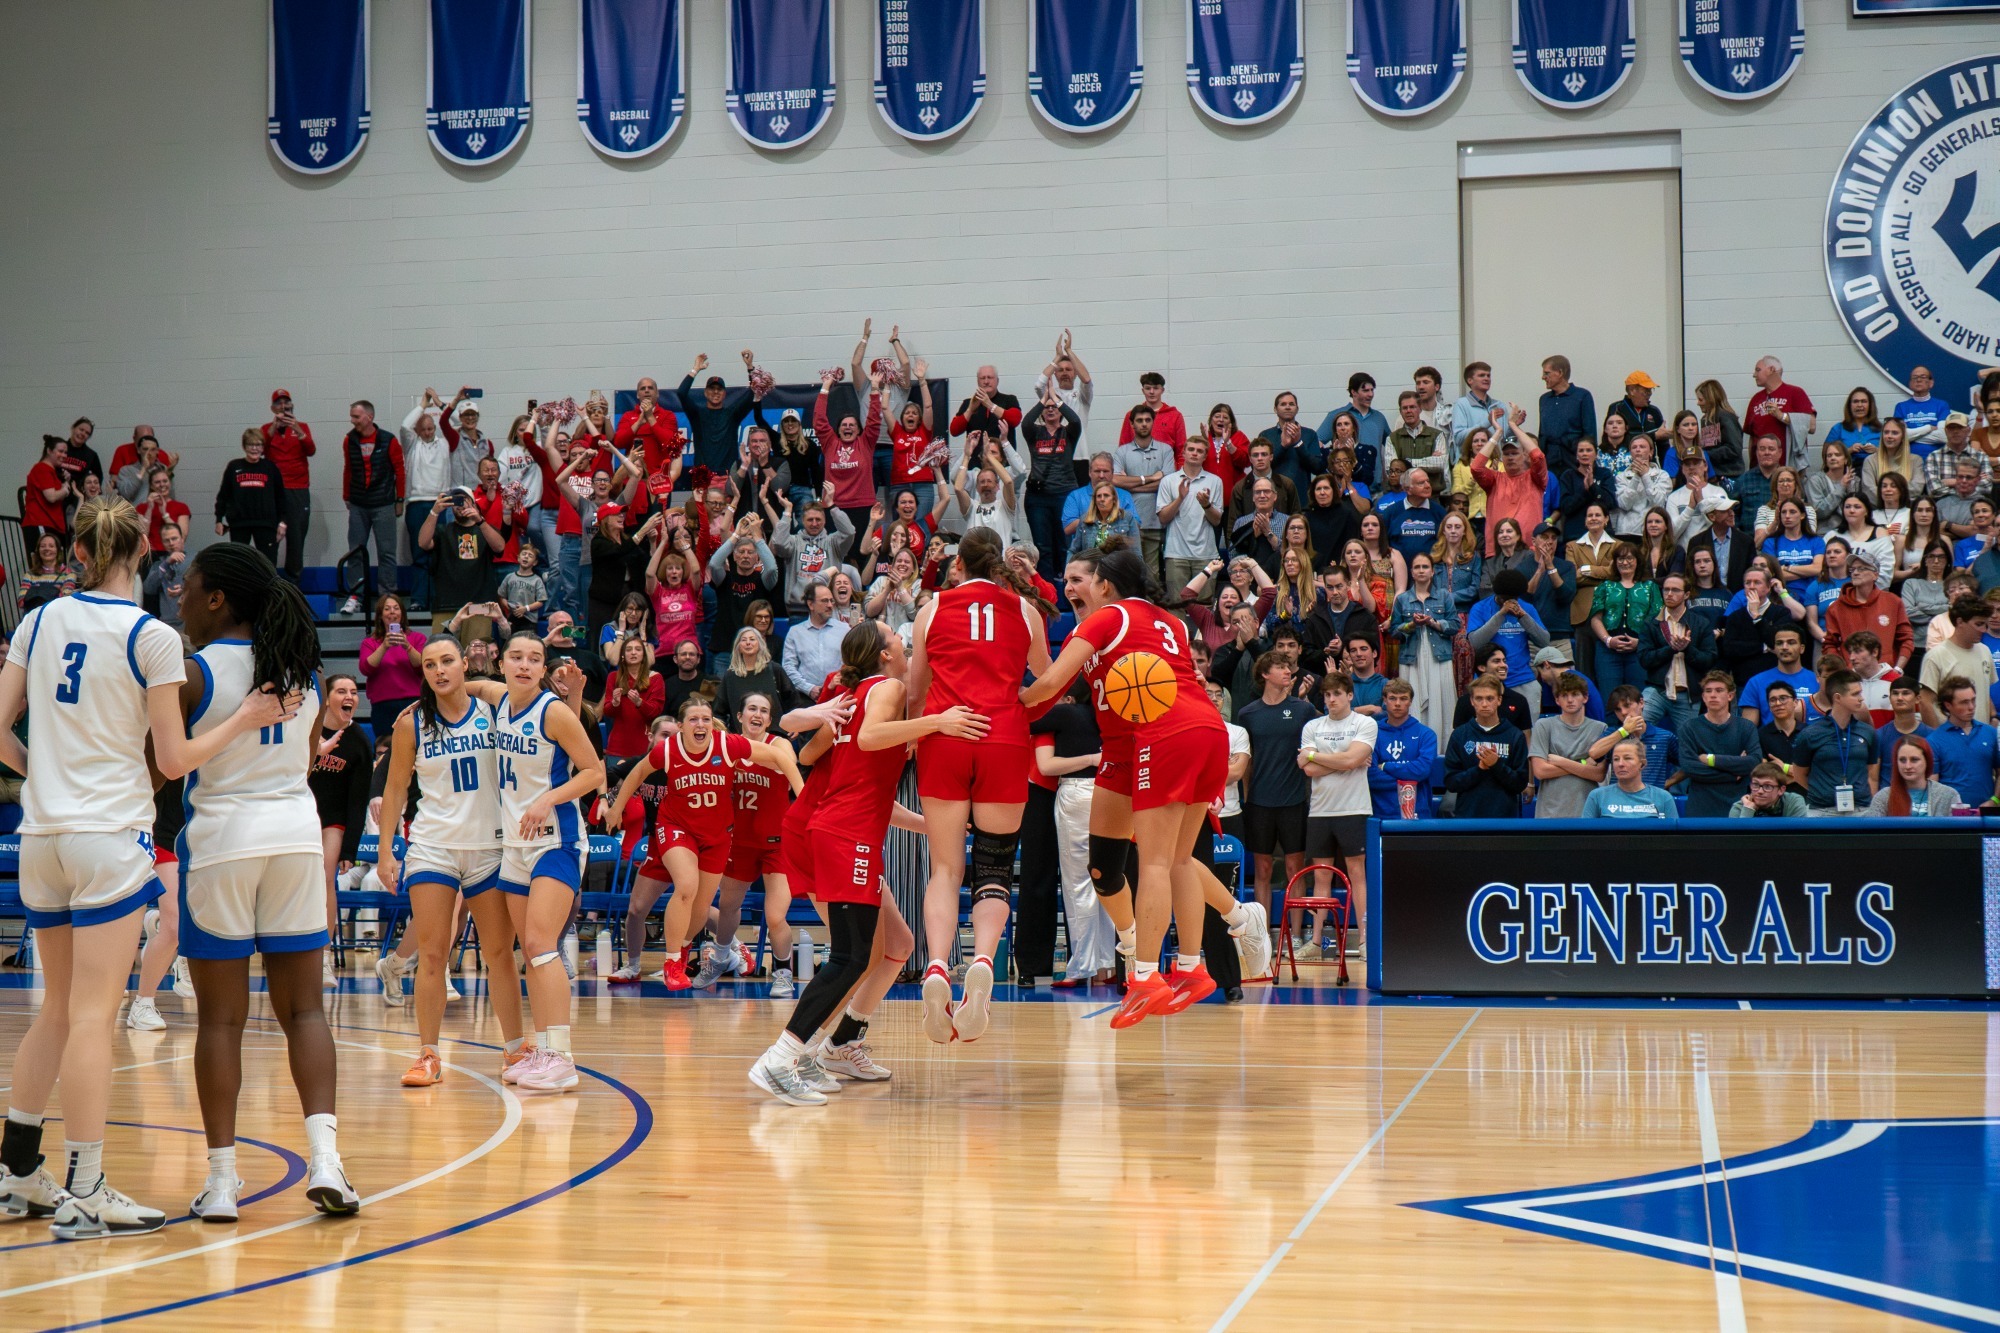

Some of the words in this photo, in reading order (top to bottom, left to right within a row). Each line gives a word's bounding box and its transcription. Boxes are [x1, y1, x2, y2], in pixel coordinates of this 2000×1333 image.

[886, 0, 908, 10] 1997
[1199, 5, 1221, 15] 2019
[886, 12, 908, 22] 1999
[1695, 11, 1719, 22] 2008
[886, 23, 909, 33] 2008
[1695, 23, 1719, 35] 2009
[886, 34, 908, 45] 2009
[1720, 37, 1764, 48] WOMEN'S
[886, 46, 908, 56] 2016
[1537, 47, 1564, 59] MEN'S
[1566, 45, 1607, 56] OUTDOOR
[1725, 47, 1760, 58] TENNIS
[886, 57, 908, 67] 2019
[1539, 57, 1568, 69] TRACK
[1570, 57, 1576, 67] &
[1579, 56, 1604, 66] FIELD
[1230, 64, 1258, 75] MEN'S
[1375, 66, 1400, 78] FIELD
[1403, 64, 1438, 75] HOCKEY
[1071, 73, 1099, 83] MEN'S
[1208, 75, 1237, 87] CROSS
[1239, 73, 1280, 85] COUNTRY
[916, 82, 943, 92] MEN'S
[1068, 82, 1102, 94] SOCCER
[1949, 64, 2000, 109] AT
[744, 90, 782, 103] WOMEN'S
[784, 88, 817, 100] INDOOR
[919, 92, 940, 102] GOLF
[749, 100, 776, 112] TRACK
[778, 100, 784, 110] &
[786, 99, 811, 109] FIELD
[440, 109, 477, 121] WOMEN'S
[478, 107, 515, 119] OUTDOOR
[610, 109, 650, 121] BASEBALL
[300, 117, 337, 129] WOMEN'S
[447, 119, 473, 130] TRACK
[475, 118, 481, 128] &
[483, 117, 506, 127] FIELD
[309, 127, 328, 138] GOLF
[1919, 117, 2000, 173] GENERALS
[1835, 89, 1943, 258] DOMINION
[1902, 170, 1927, 195] GO
[1891, 211, 1912, 241] ALL
[1891, 249, 1937, 320] RESPECT
[1843, 274, 1899, 342] OLD
[1942, 320, 1990, 355] HARD
[967, 602, 994, 642] 11
[1154, 620, 1179, 655] 3
[56, 642, 88, 704] 3
[424, 732, 495, 759] GENERALS
[451, 756, 479, 792] 10
[499, 755, 517, 791] 14
[1138, 767, 1151, 791] BIG
[675, 773, 725, 790] DENISON
[687, 791, 717, 809] 30
[739, 789, 758, 811] 12
[657, 826, 666, 845] RED
[853, 858, 869, 886] RED
[1466, 880, 1896, 966] GENERALS
